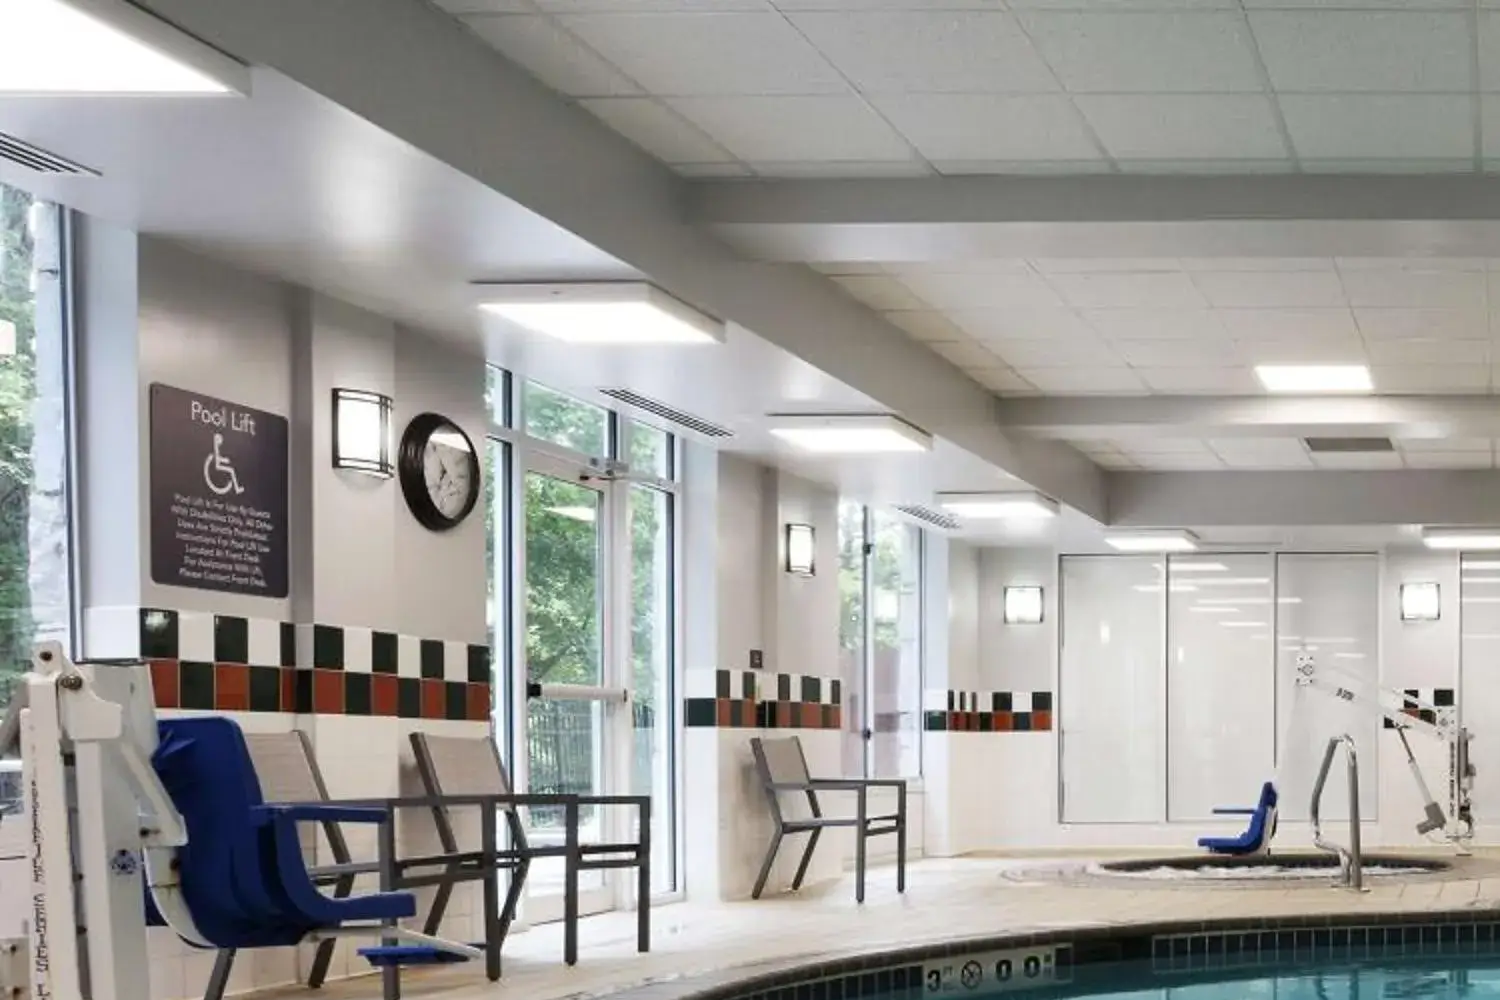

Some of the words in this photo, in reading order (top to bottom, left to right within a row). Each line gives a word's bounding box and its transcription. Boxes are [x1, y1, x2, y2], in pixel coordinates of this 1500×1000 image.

[191, 400, 226, 428] Pool
[231, 410, 256, 437] Lift
[927, 969, 941, 992] 3
